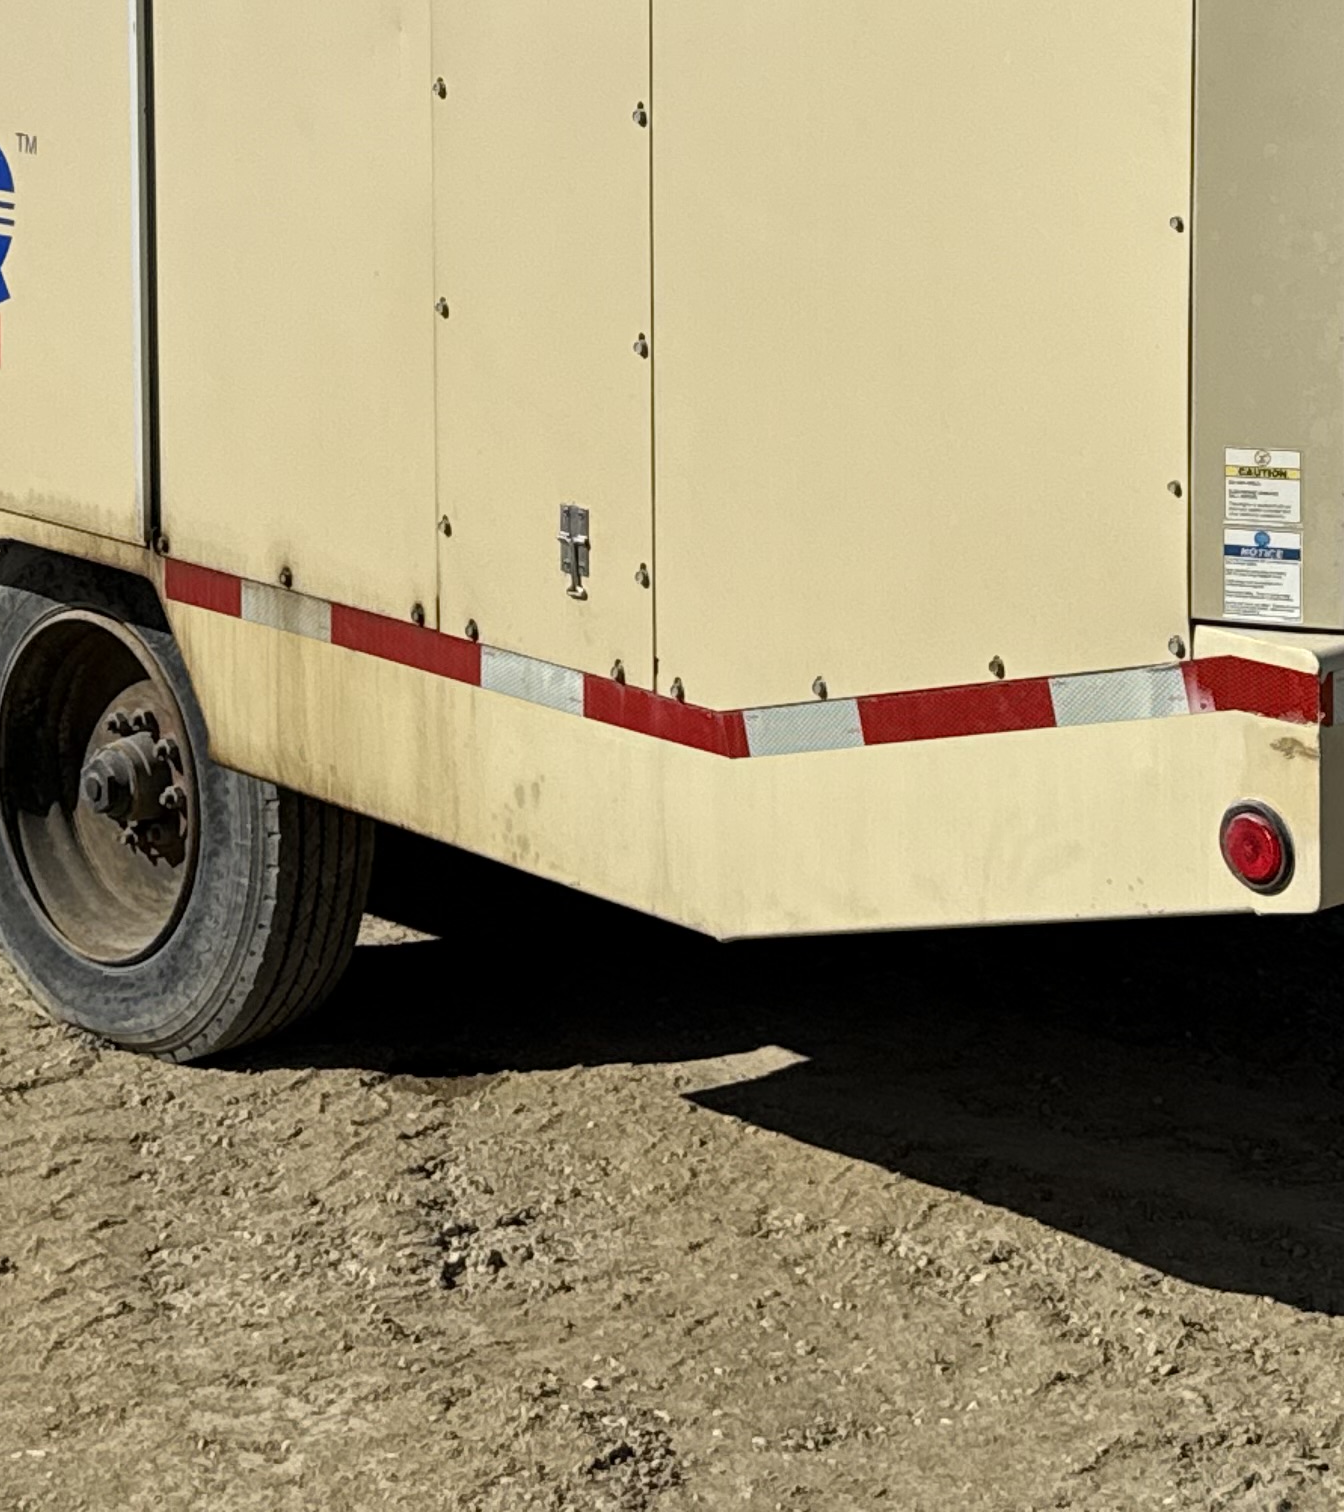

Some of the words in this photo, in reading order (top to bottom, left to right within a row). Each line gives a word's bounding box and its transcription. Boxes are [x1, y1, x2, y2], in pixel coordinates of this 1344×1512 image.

[16, 132, 38, 155] TM
[1238, 467, 1287, 478] CAUTION
[1240, 547, 1284, 559] NOTICE
